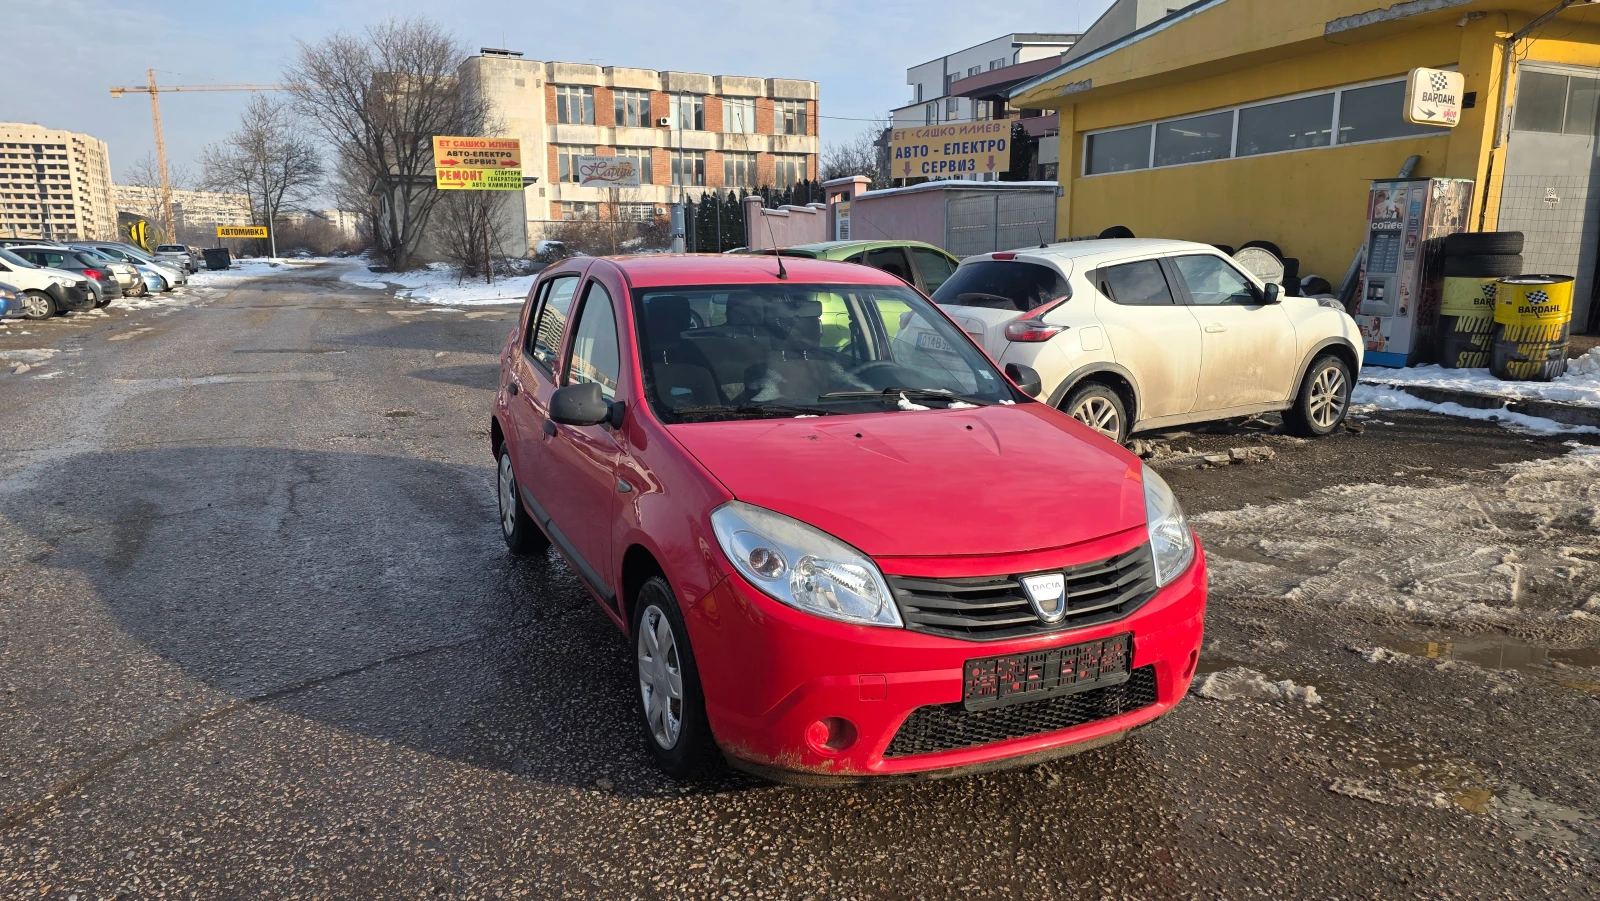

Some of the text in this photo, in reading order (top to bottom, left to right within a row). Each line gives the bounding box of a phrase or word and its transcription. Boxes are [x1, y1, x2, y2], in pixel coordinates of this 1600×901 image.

[1422, 92, 1456, 106] BARDAHL
[894, 123, 1000, 140] ЕТ САШКО ИЛИЕВ
[895, 144, 928, 159] АВТО
[944, 139, 1005, 155] ЕЛЕКТРО
[922, 159, 975, 174] СЕРВИЗ
[438, 170, 483, 181] РЕМОНТ
[1372, 221, 1403, 229] coffee
[1518, 305, 1560, 316] BARDAHL
[1502, 324, 1562, 342] NOTHING
[1456, 351, 1490, 367] STOP
[1517, 343, 1549, 360] WILL
[1506, 361, 1541, 379] STOP
[1033, 582, 1061, 591] DACIA
